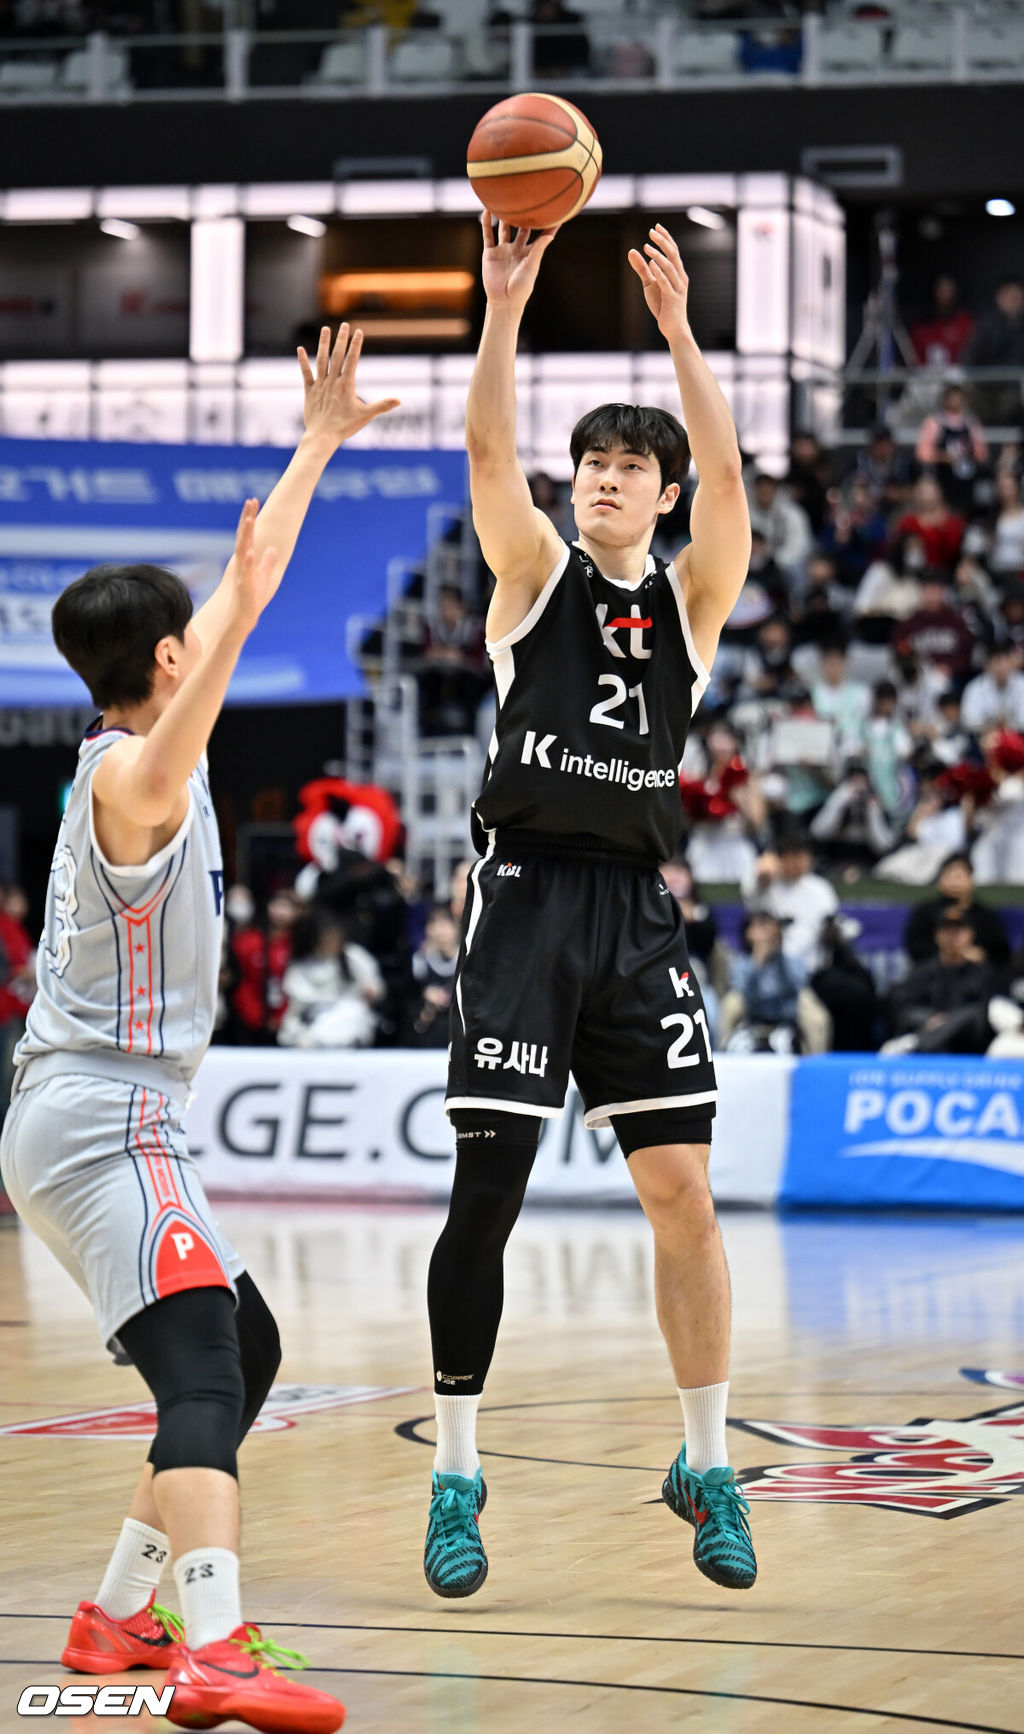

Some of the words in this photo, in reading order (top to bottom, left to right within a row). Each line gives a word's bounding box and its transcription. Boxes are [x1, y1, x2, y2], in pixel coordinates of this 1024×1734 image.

[595, 603, 652, 659] kt
[589, 674, 649, 735] 21
[521, 731, 557, 769] K
[560, 748, 675, 791] intelligence
[668, 967, 695, 998] k
[474, 1037, 548, 1078] 유사나
[660, 1008, 713, 1069] 21
[844, 1089, 1024, 1137] POCA
[170, 1232, 194, 1260] P
[142, 1544, 167, 1563] 23
[185, 1563, 214, 1584] 23
